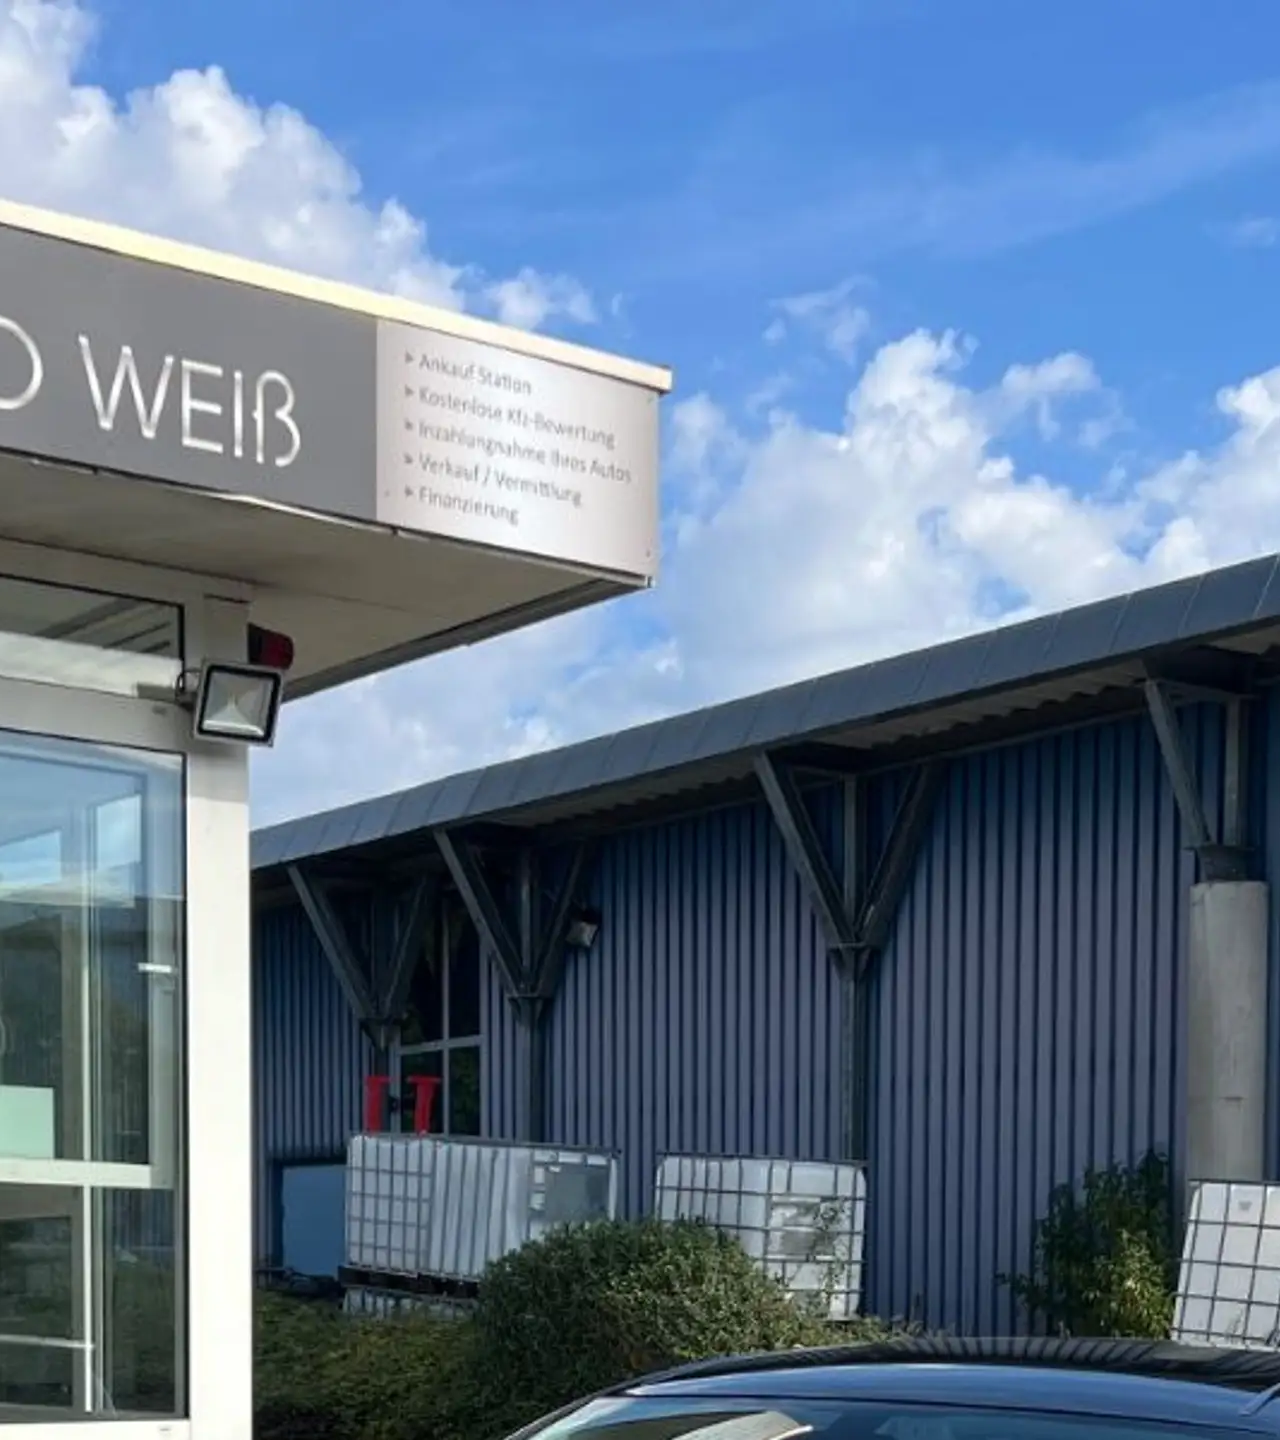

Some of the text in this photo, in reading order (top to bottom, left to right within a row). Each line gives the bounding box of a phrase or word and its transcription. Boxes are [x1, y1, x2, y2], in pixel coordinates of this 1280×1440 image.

[419, 353, 532, 396] Ankauf Station
[79, 335, 301, 467] WEIß
[419, 387, 616, 450] Kostenlose Kfz-Bewertung
[419, 453, 479, 482] Verkauf
[589, 459, 632, 484] Autos
[419, 486, 520, 527] Finanzierung
